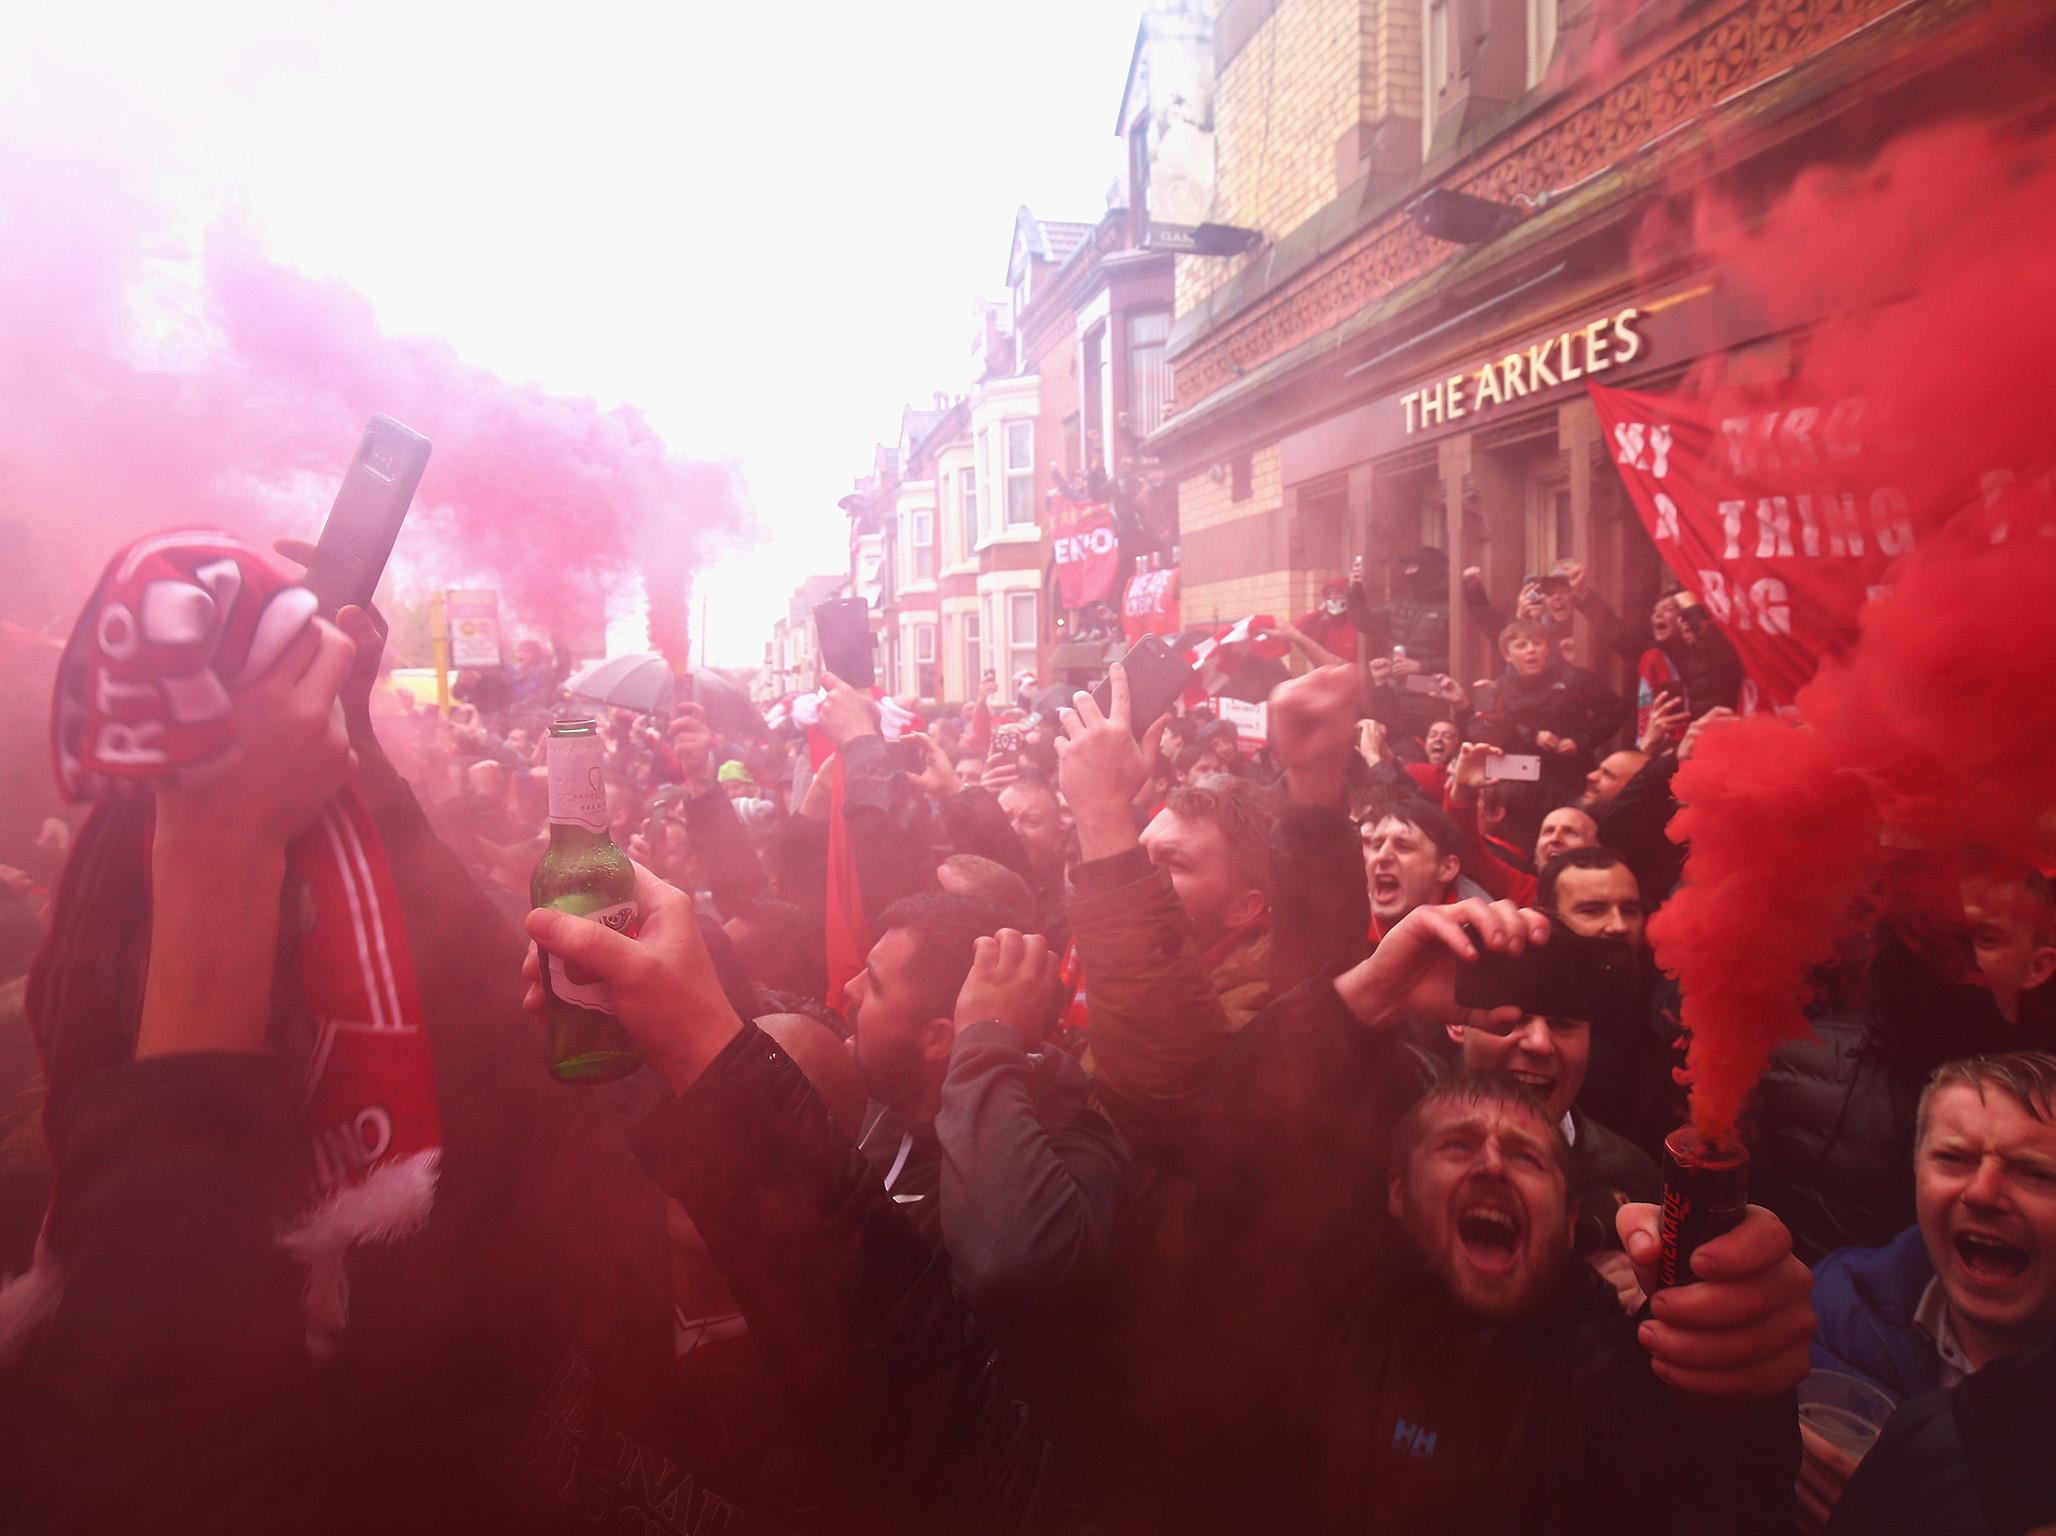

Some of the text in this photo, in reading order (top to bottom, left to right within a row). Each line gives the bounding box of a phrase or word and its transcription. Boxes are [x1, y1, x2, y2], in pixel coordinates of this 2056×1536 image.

[1400, 308, 1639, 434] THE ARKLES
[1613, 421, 1673, 479] MY
[1717, 487, 1915, 560] THING
[1697, 569, 1792, 635] BIG
[1391, 1416, 1438, 1461] HH
